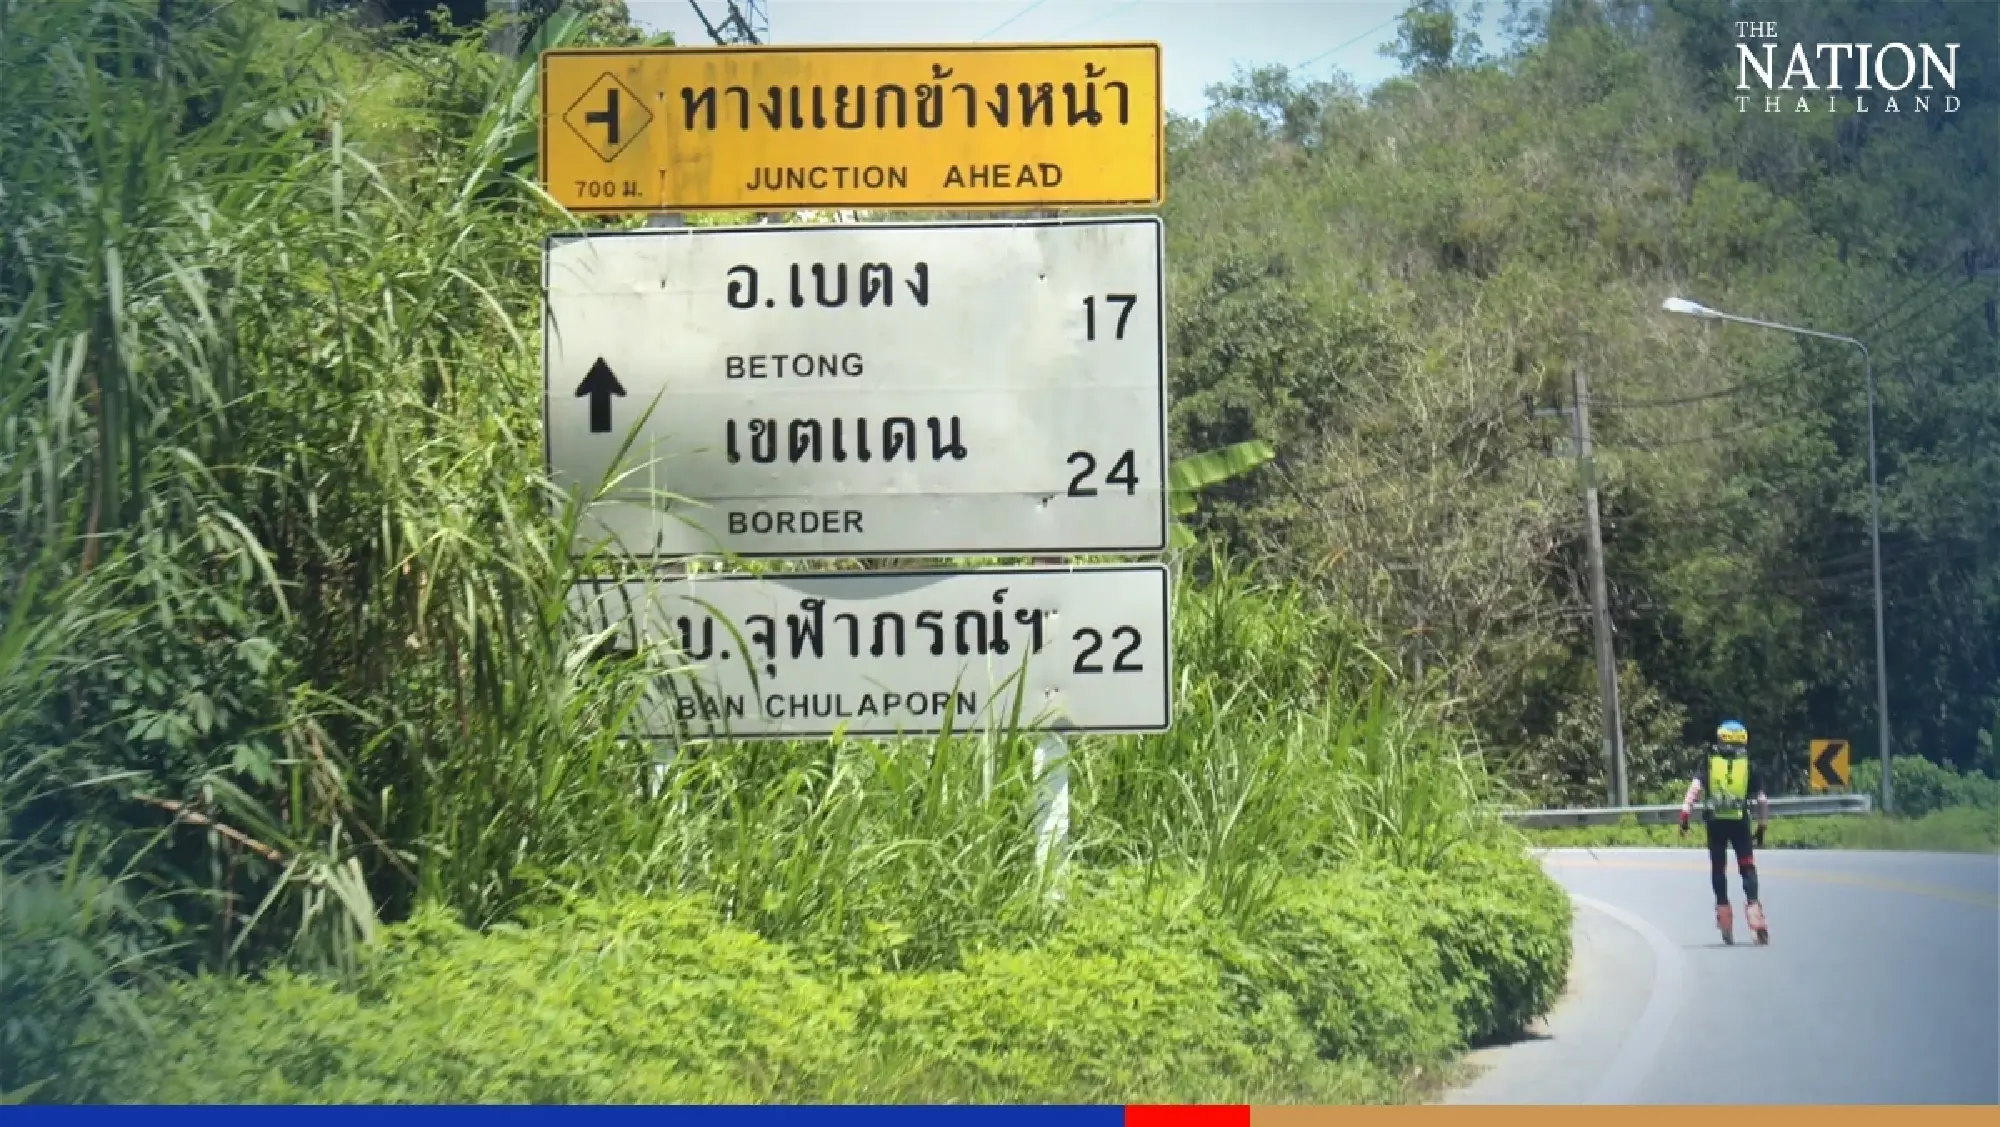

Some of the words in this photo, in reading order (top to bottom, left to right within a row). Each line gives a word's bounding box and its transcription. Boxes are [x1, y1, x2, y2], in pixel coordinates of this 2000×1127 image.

[680, 62, 1130, 132] ทางแยกข้างหน้า
[575, 180, 616, 198] 700
[746, 166, 908, 190] JUNCTION
[942, 163, 1063, 189] AHEAD
[1082, 295, 1138, 341] 17
[726, 353, 865, 378] BETONG
[726, 414, 968, 463] เขตแดน
[1066, 449, 1139, 497] 24
[728, 510, 865, 534] BORDER
[1072, 625, 1143, 674] 22
[677, 694, 744, 720] BAN
[765, 690, 977, 717] CHULAPORN
